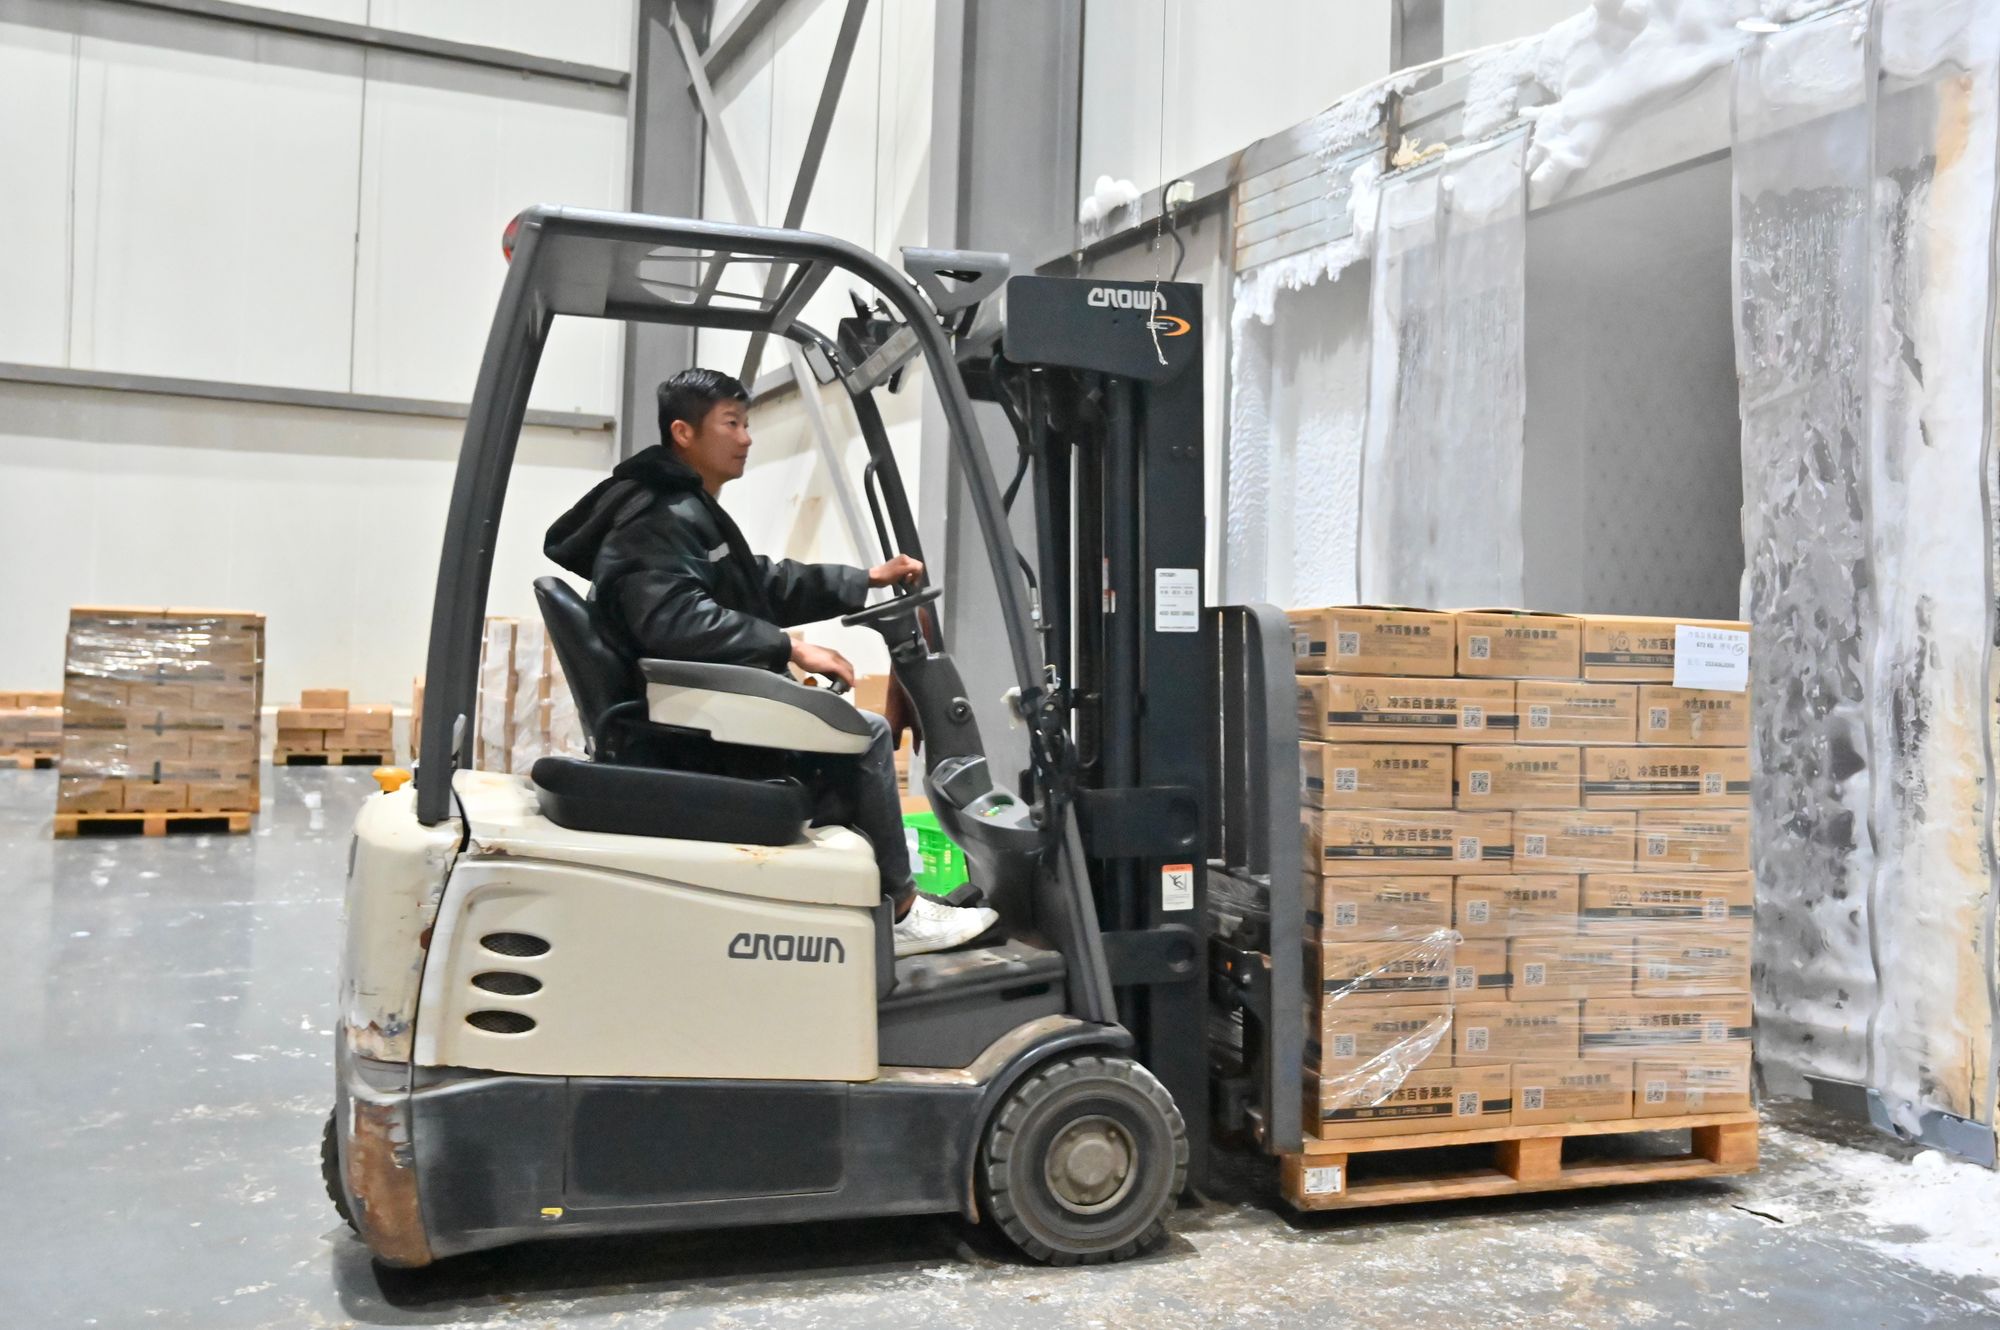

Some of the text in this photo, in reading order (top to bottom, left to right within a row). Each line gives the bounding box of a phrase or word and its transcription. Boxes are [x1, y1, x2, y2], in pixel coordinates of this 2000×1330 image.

[1088, 288, 1167, 310] CROWN
[1387, 696, 1457, 710] 冷冻百香果浆
[1637, 764, 1701, 777] 冷冻百香果浆
[1382, 828, 1454, 842] 冷冻百香果浆
[728, 932, 845, 964] CROWN
